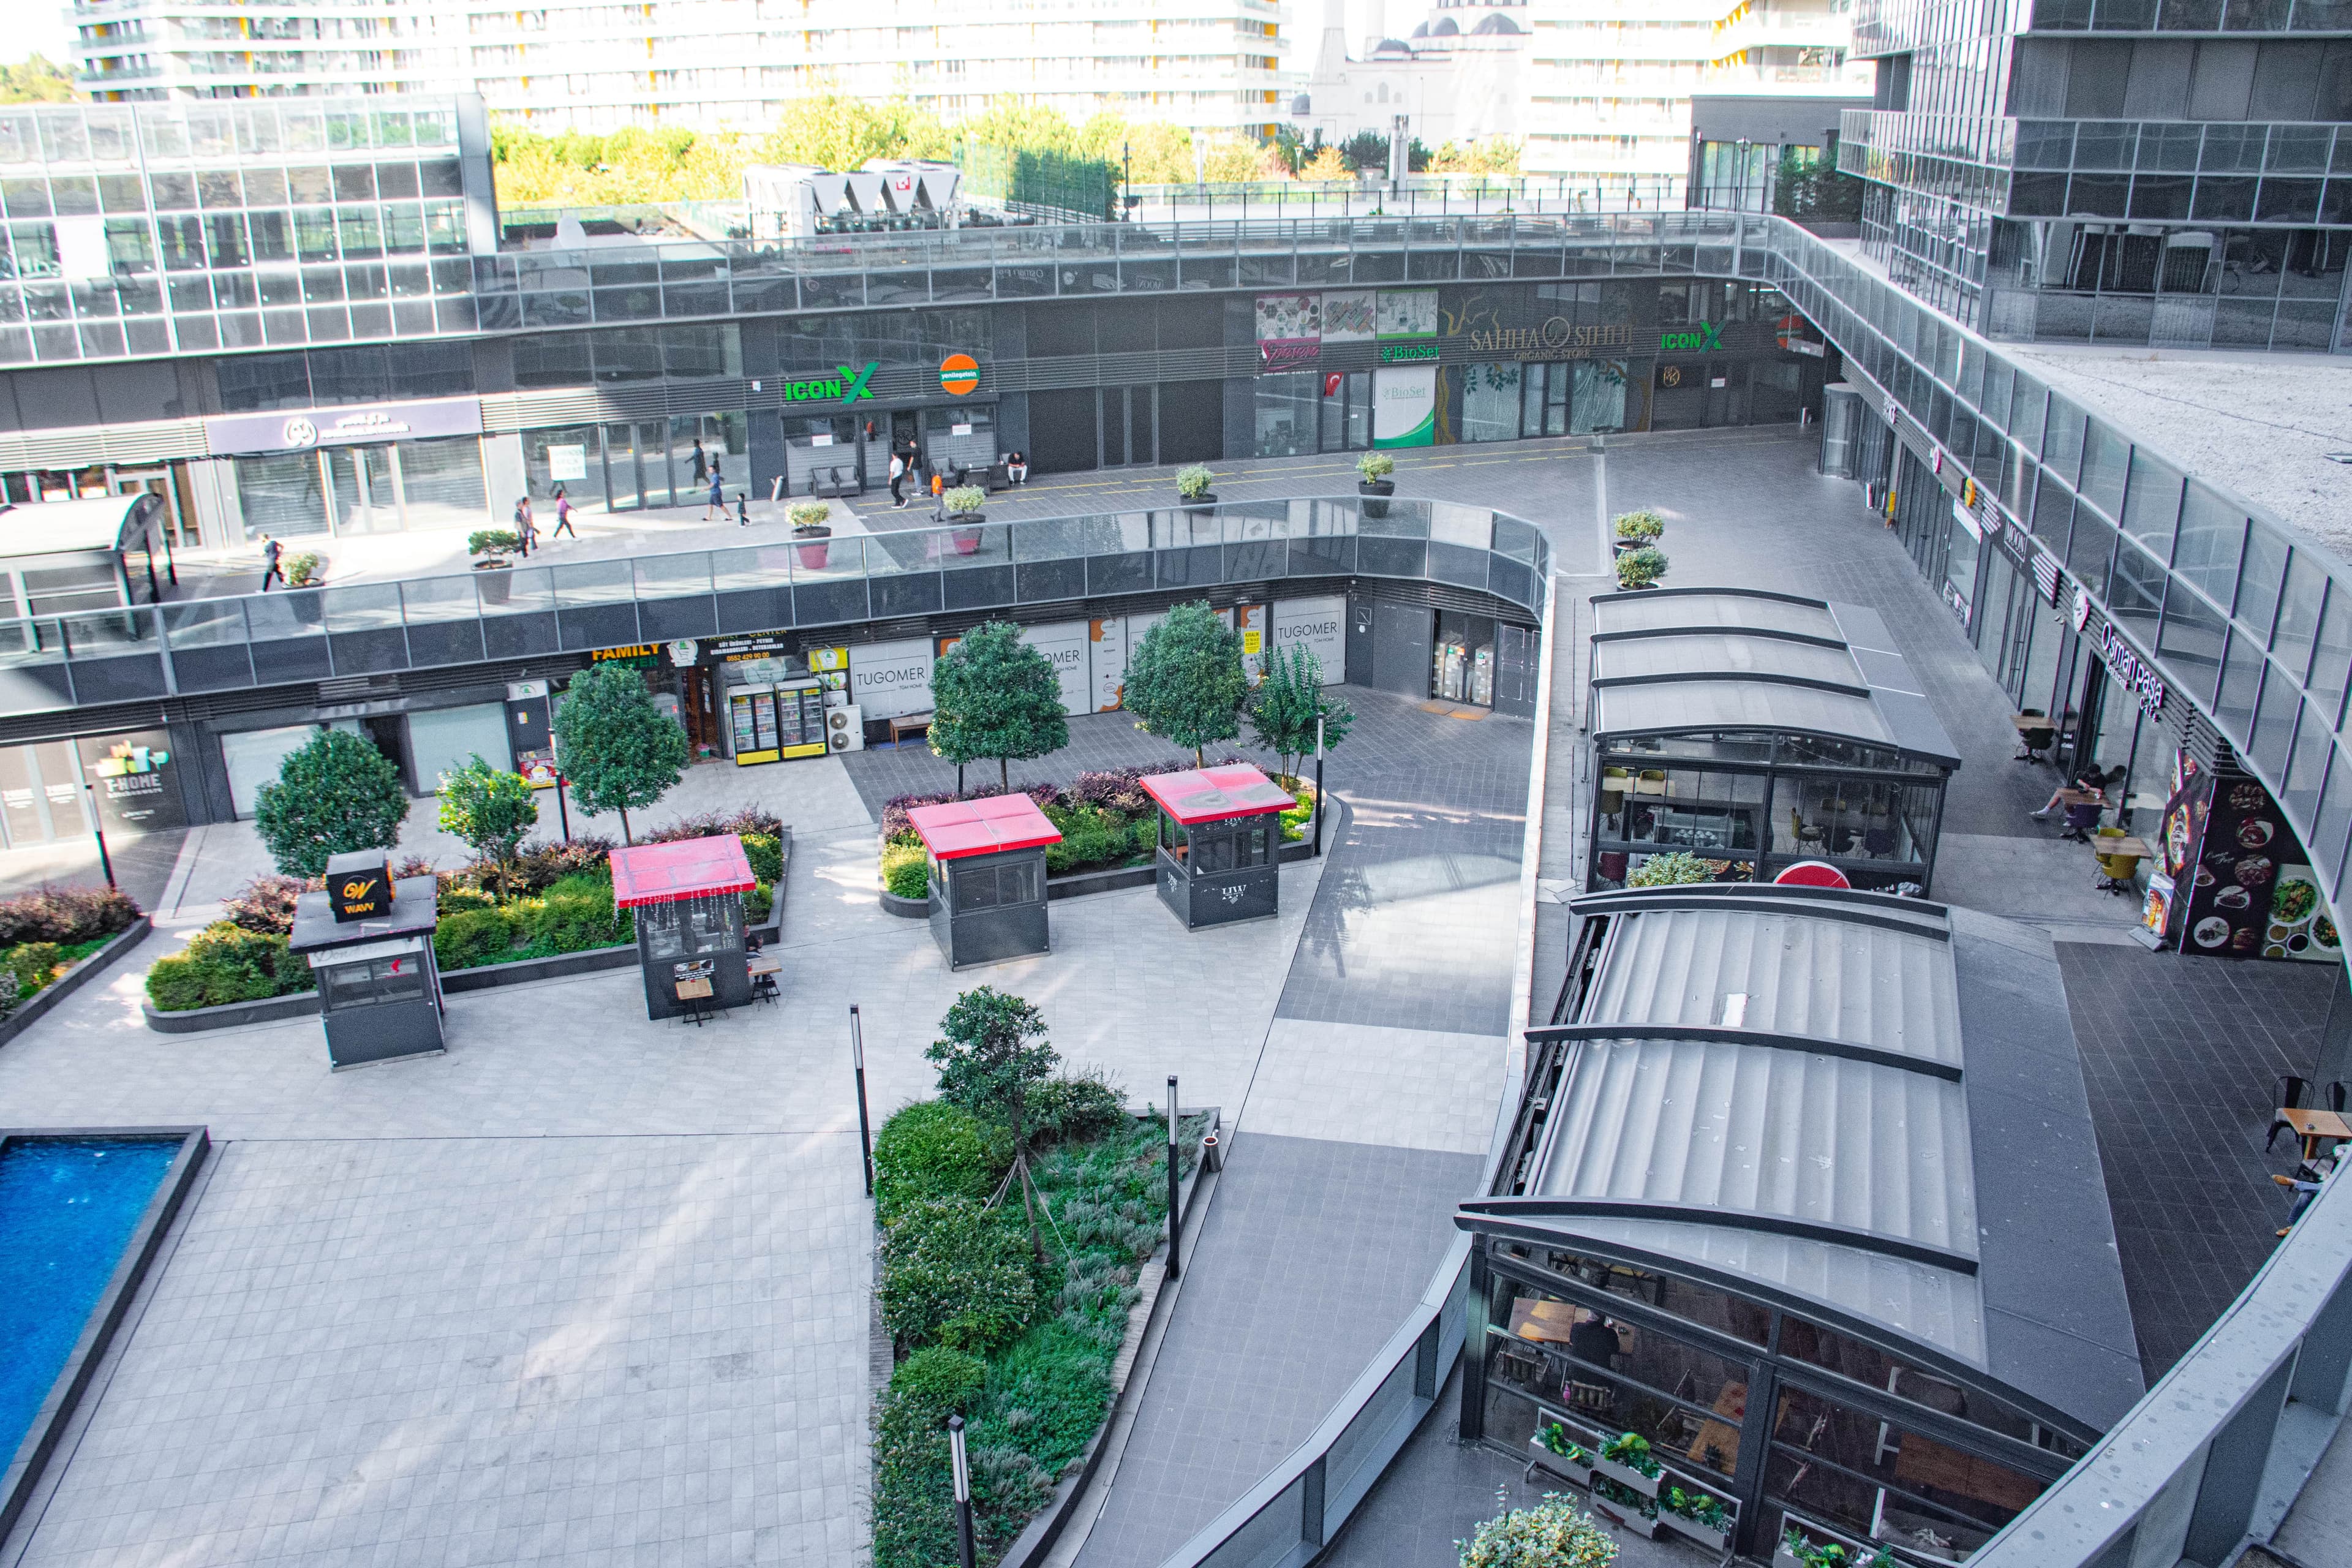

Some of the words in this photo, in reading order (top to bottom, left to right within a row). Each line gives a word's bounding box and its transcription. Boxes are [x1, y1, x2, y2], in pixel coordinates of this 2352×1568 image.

[1660, 333, 1701, 350] ICON
[1393, 344, 1440, 360] BioSet
[1513, 349, 1559, 361] ORGANIC
[1561, 347, 1591, 360] STORE
[785, 380, 842, 401] ICON
[1391, 386, 1427, 398] BioSet
[2007, 521, 2026, 555] MOON
[1278, 622, 1338, 639] TUGOMER
[592, 643, 660, 661] FAMILY
[1042, 650, 1080, 663] OMER
[856, 667, 925, 686] TUGOMER
